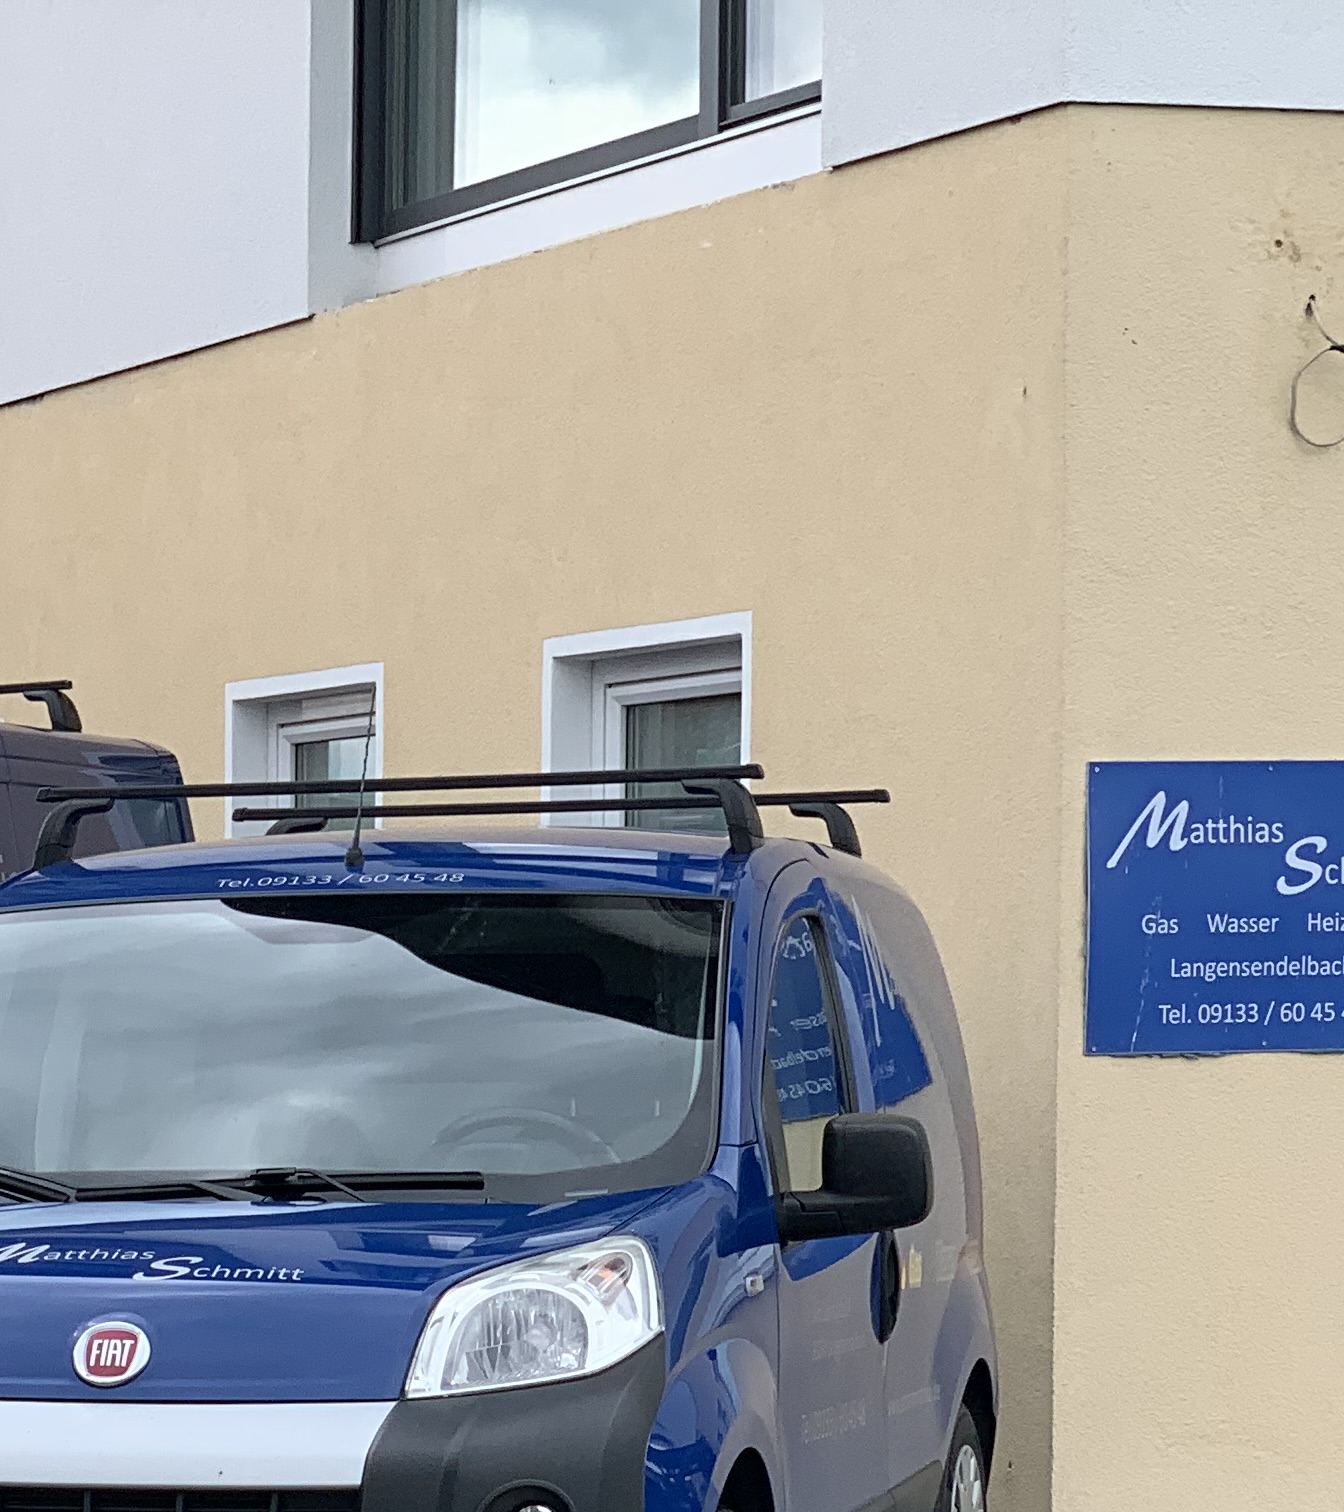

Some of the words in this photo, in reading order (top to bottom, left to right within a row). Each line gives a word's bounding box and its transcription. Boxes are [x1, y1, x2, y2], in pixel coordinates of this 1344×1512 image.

[1106, 790, 1285, 869] Matthias
[1276, 835, 1344, 895] Sc
[358, 873, 389, 884] 60
[395, 873, 425, 883] 45
[433, 872, 465, 883] 48
[1141, 914, 1179, 934] Gas
[1206, 913, 1280, 933] Wasser
[1170, 955, 1344, 981] Langensendelbac
[1158, 1004, 1192, 1024] Tel.
[1198, 1003, 1259, 1024] 09133
[1263, 1001, 1275, 1026] /
[1280, 1002, 1305, 1022] 60
[1310, 1002, 1335, 1022] 45
[132, 1256, 305, 1281] Schmitt
[89, 1338, 135, 1367] FIAT
